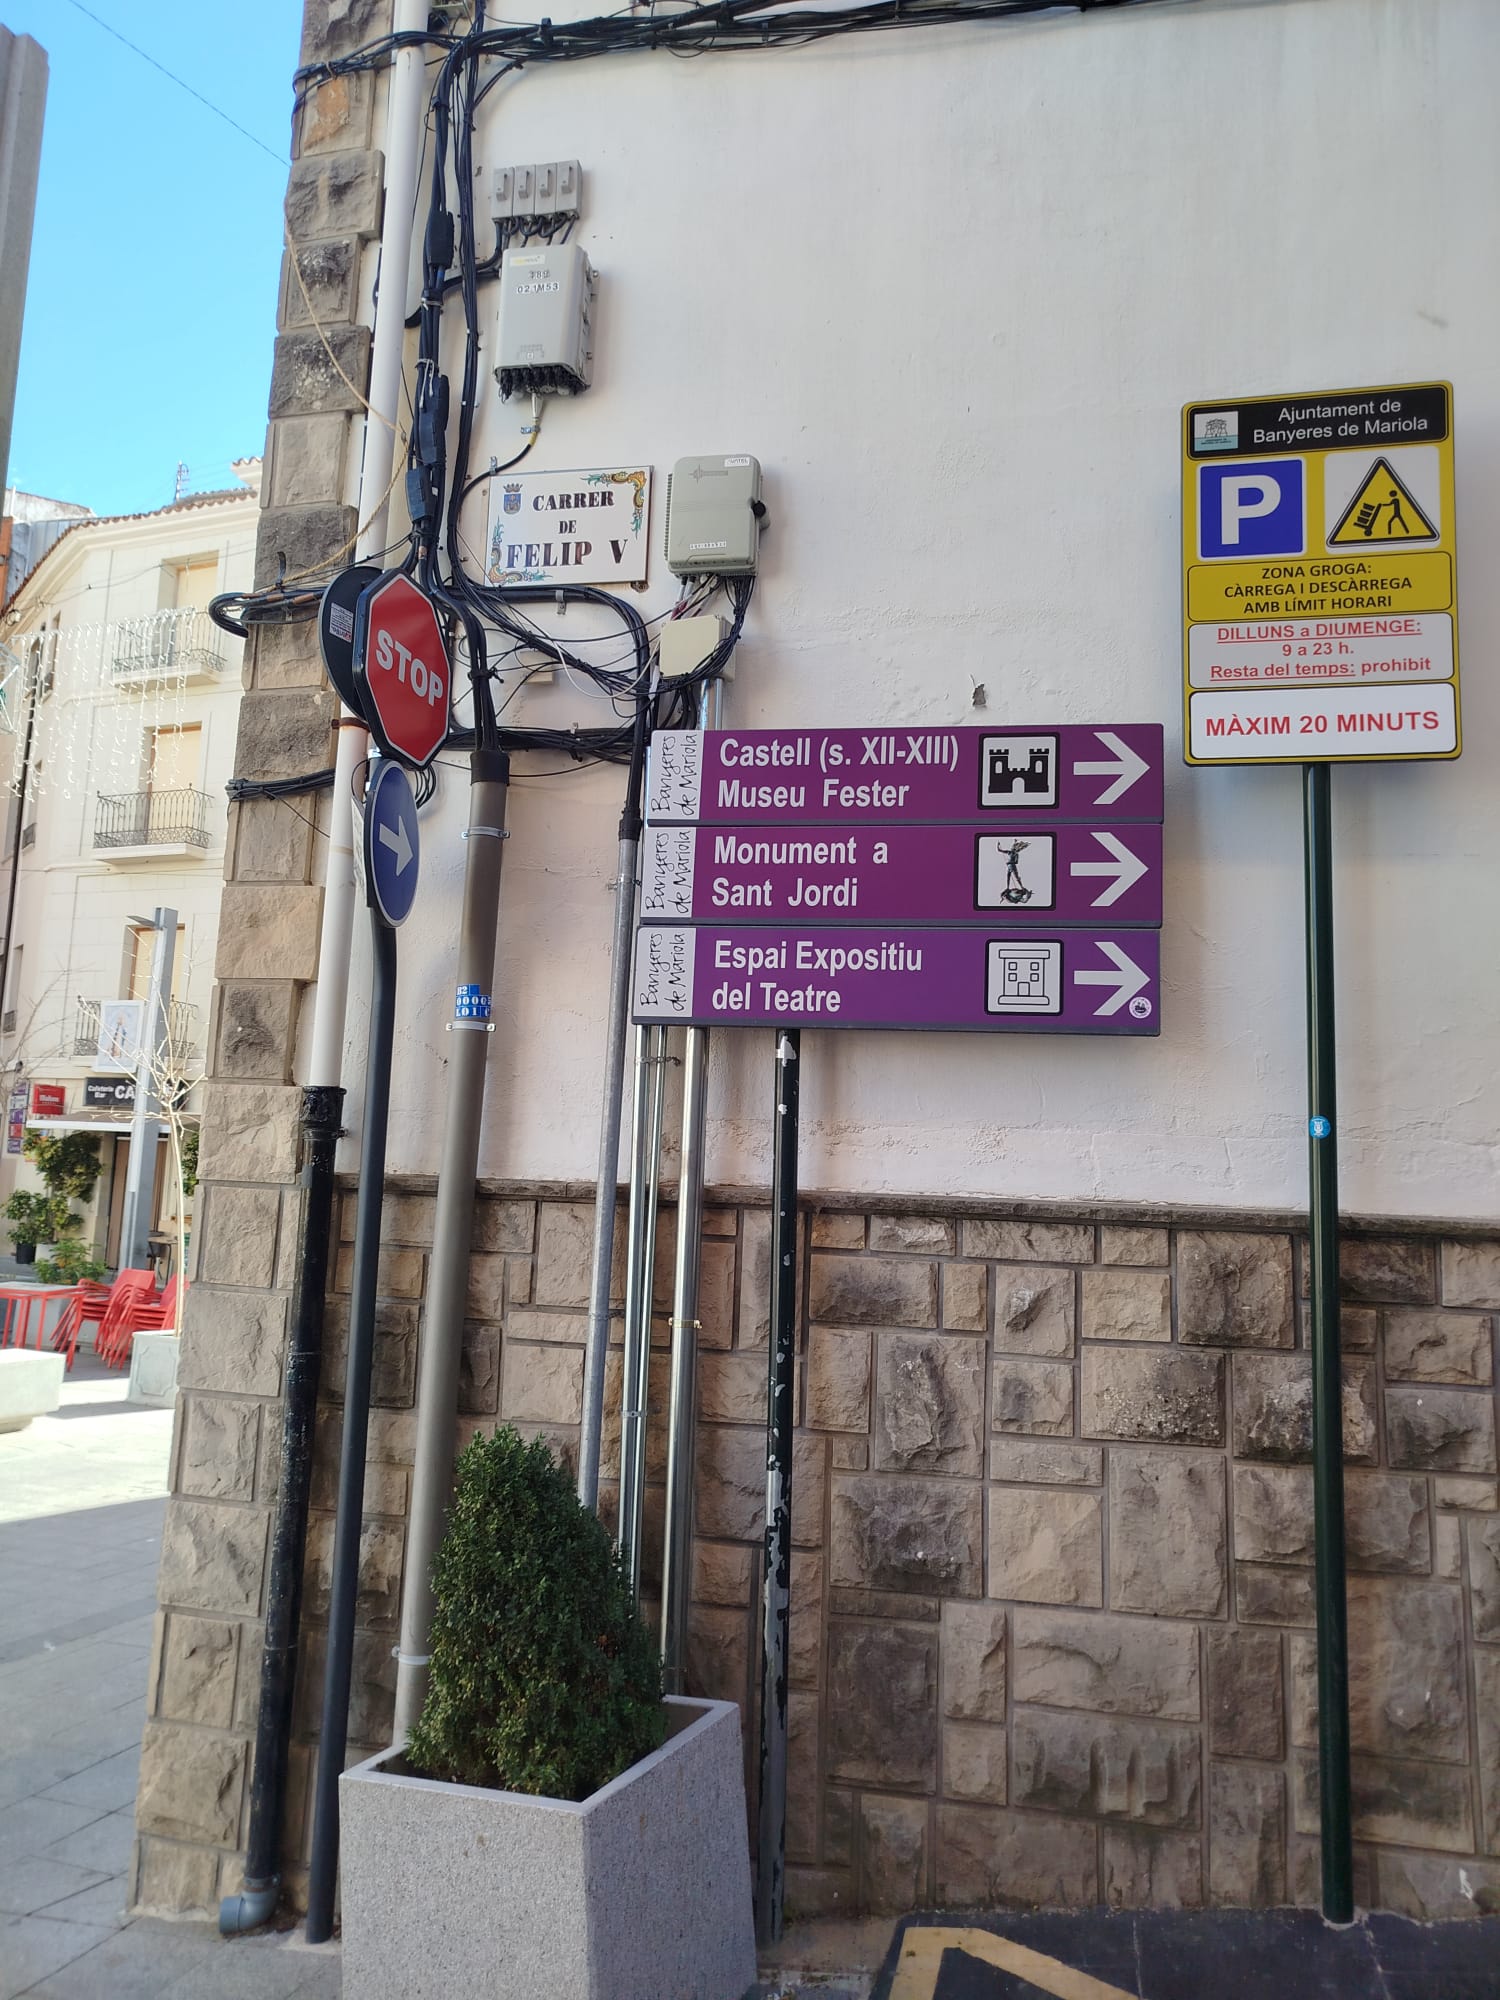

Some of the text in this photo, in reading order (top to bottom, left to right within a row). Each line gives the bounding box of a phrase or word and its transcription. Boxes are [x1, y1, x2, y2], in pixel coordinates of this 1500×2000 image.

[1277, 399, 1402, 424] Ajuntament de
[1253, 426, 1333, 445] Banyeres
[1337, 421, 1360, 437] de
[1364, 416, 1428, 435] Mariola
[532, 490, 614, 511] CARRER
[1220, 474, 1282, 545] P
[558, 519, 577, 534] DE
[506, 538, 629, 569] FELIP V
[1261, 562, 1372, 580] ZONA GROGA:
[1223, 577, 1412, 598] CÀRREGA I DESCÀRREGA
[1243, 595, 1392, 614] AMB LÍMIT HORARI
[1216, 619, 1422, 642] DILLUNS a DIUMENGE:
[1282, 641, 1354, 656] 9 a 23 h.
[375, 629, 444, 707] STOP
[1210, 657, 1431, 680] Resta del temps: prohibit
[1205, 710, 1440, 737] MÀXIM 20 MINUTS
[719, 735, 959, 773] Castell (s. XII-XIII)
[651, 735, 681, 813] Banyeres
[673, 734, 698, 817] de Mariola
[717, 778, 910, 807] Museu Fester
[714, 835, 888, 865] Monument a
[645, 832, 675, 911] Banyeres
[667, 830, 693, 914] de Mariola
[711, 877, 858, 907] Sant Jordi
[640, 932, 670, 1007] Banyeres
[663, 932, 686, 1012] de Mariola
[714, 939, 922, 977] Espai Expositiu
[712, 981, 841, 1012] del Teatre
